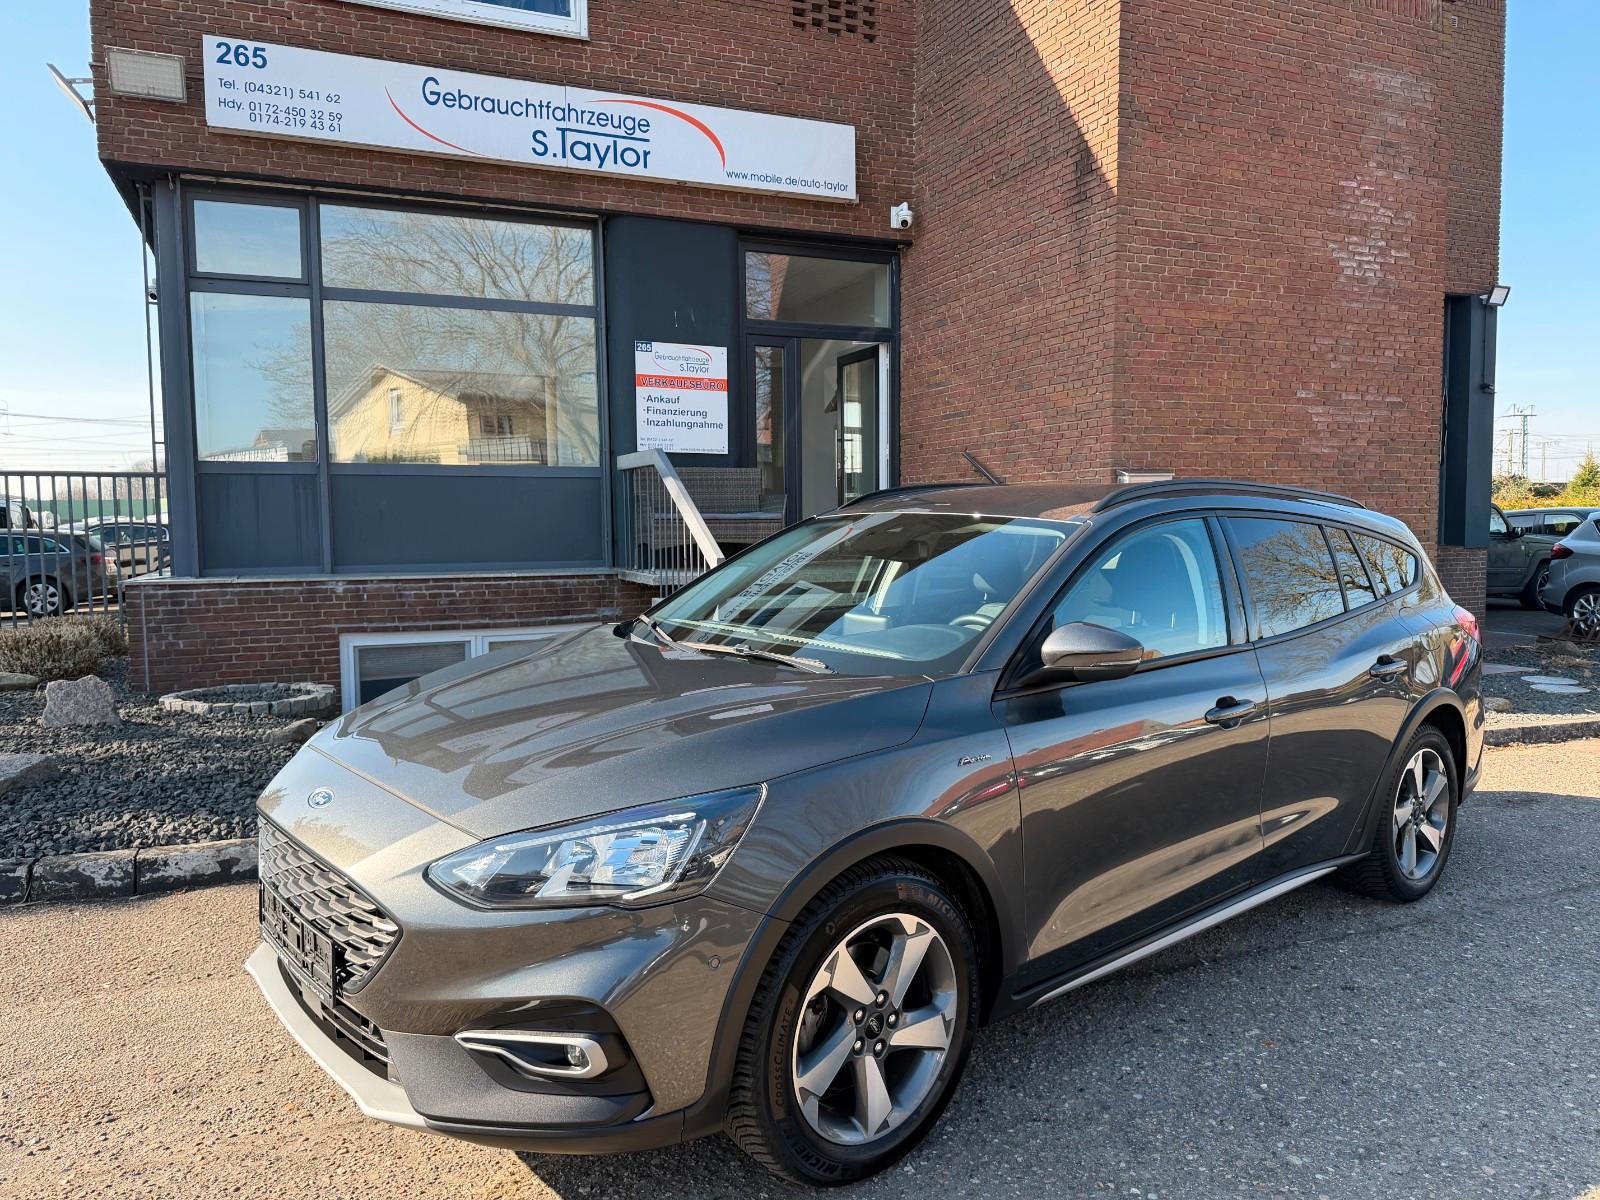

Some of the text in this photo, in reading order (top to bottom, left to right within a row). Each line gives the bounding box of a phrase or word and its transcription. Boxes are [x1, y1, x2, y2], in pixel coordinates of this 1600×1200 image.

[215, 41, 268, 69] 265
[218, 77, 341, 104] Tel. (04321) 541 62
[218, 97, 343, 123] Hdy. 0172-450 32 59
[422, 76, 651, 136] Gebrauchtfahrzeuge
[249, 112, 342, 133] 0174-219 43 61
[531, 126, 651, 170] S.Taylor
[726, 170, 849, 193] www.mobile.de/auto-taylor
[636, 343, 652, 352] 265
[679, 362, 710, 374] S.Taylor
[646, 394, 681, 404] Ankauf
[646, 406, 708, 419] Finanzierung
[646, 418, 724, 430] Inzahlungnahme
